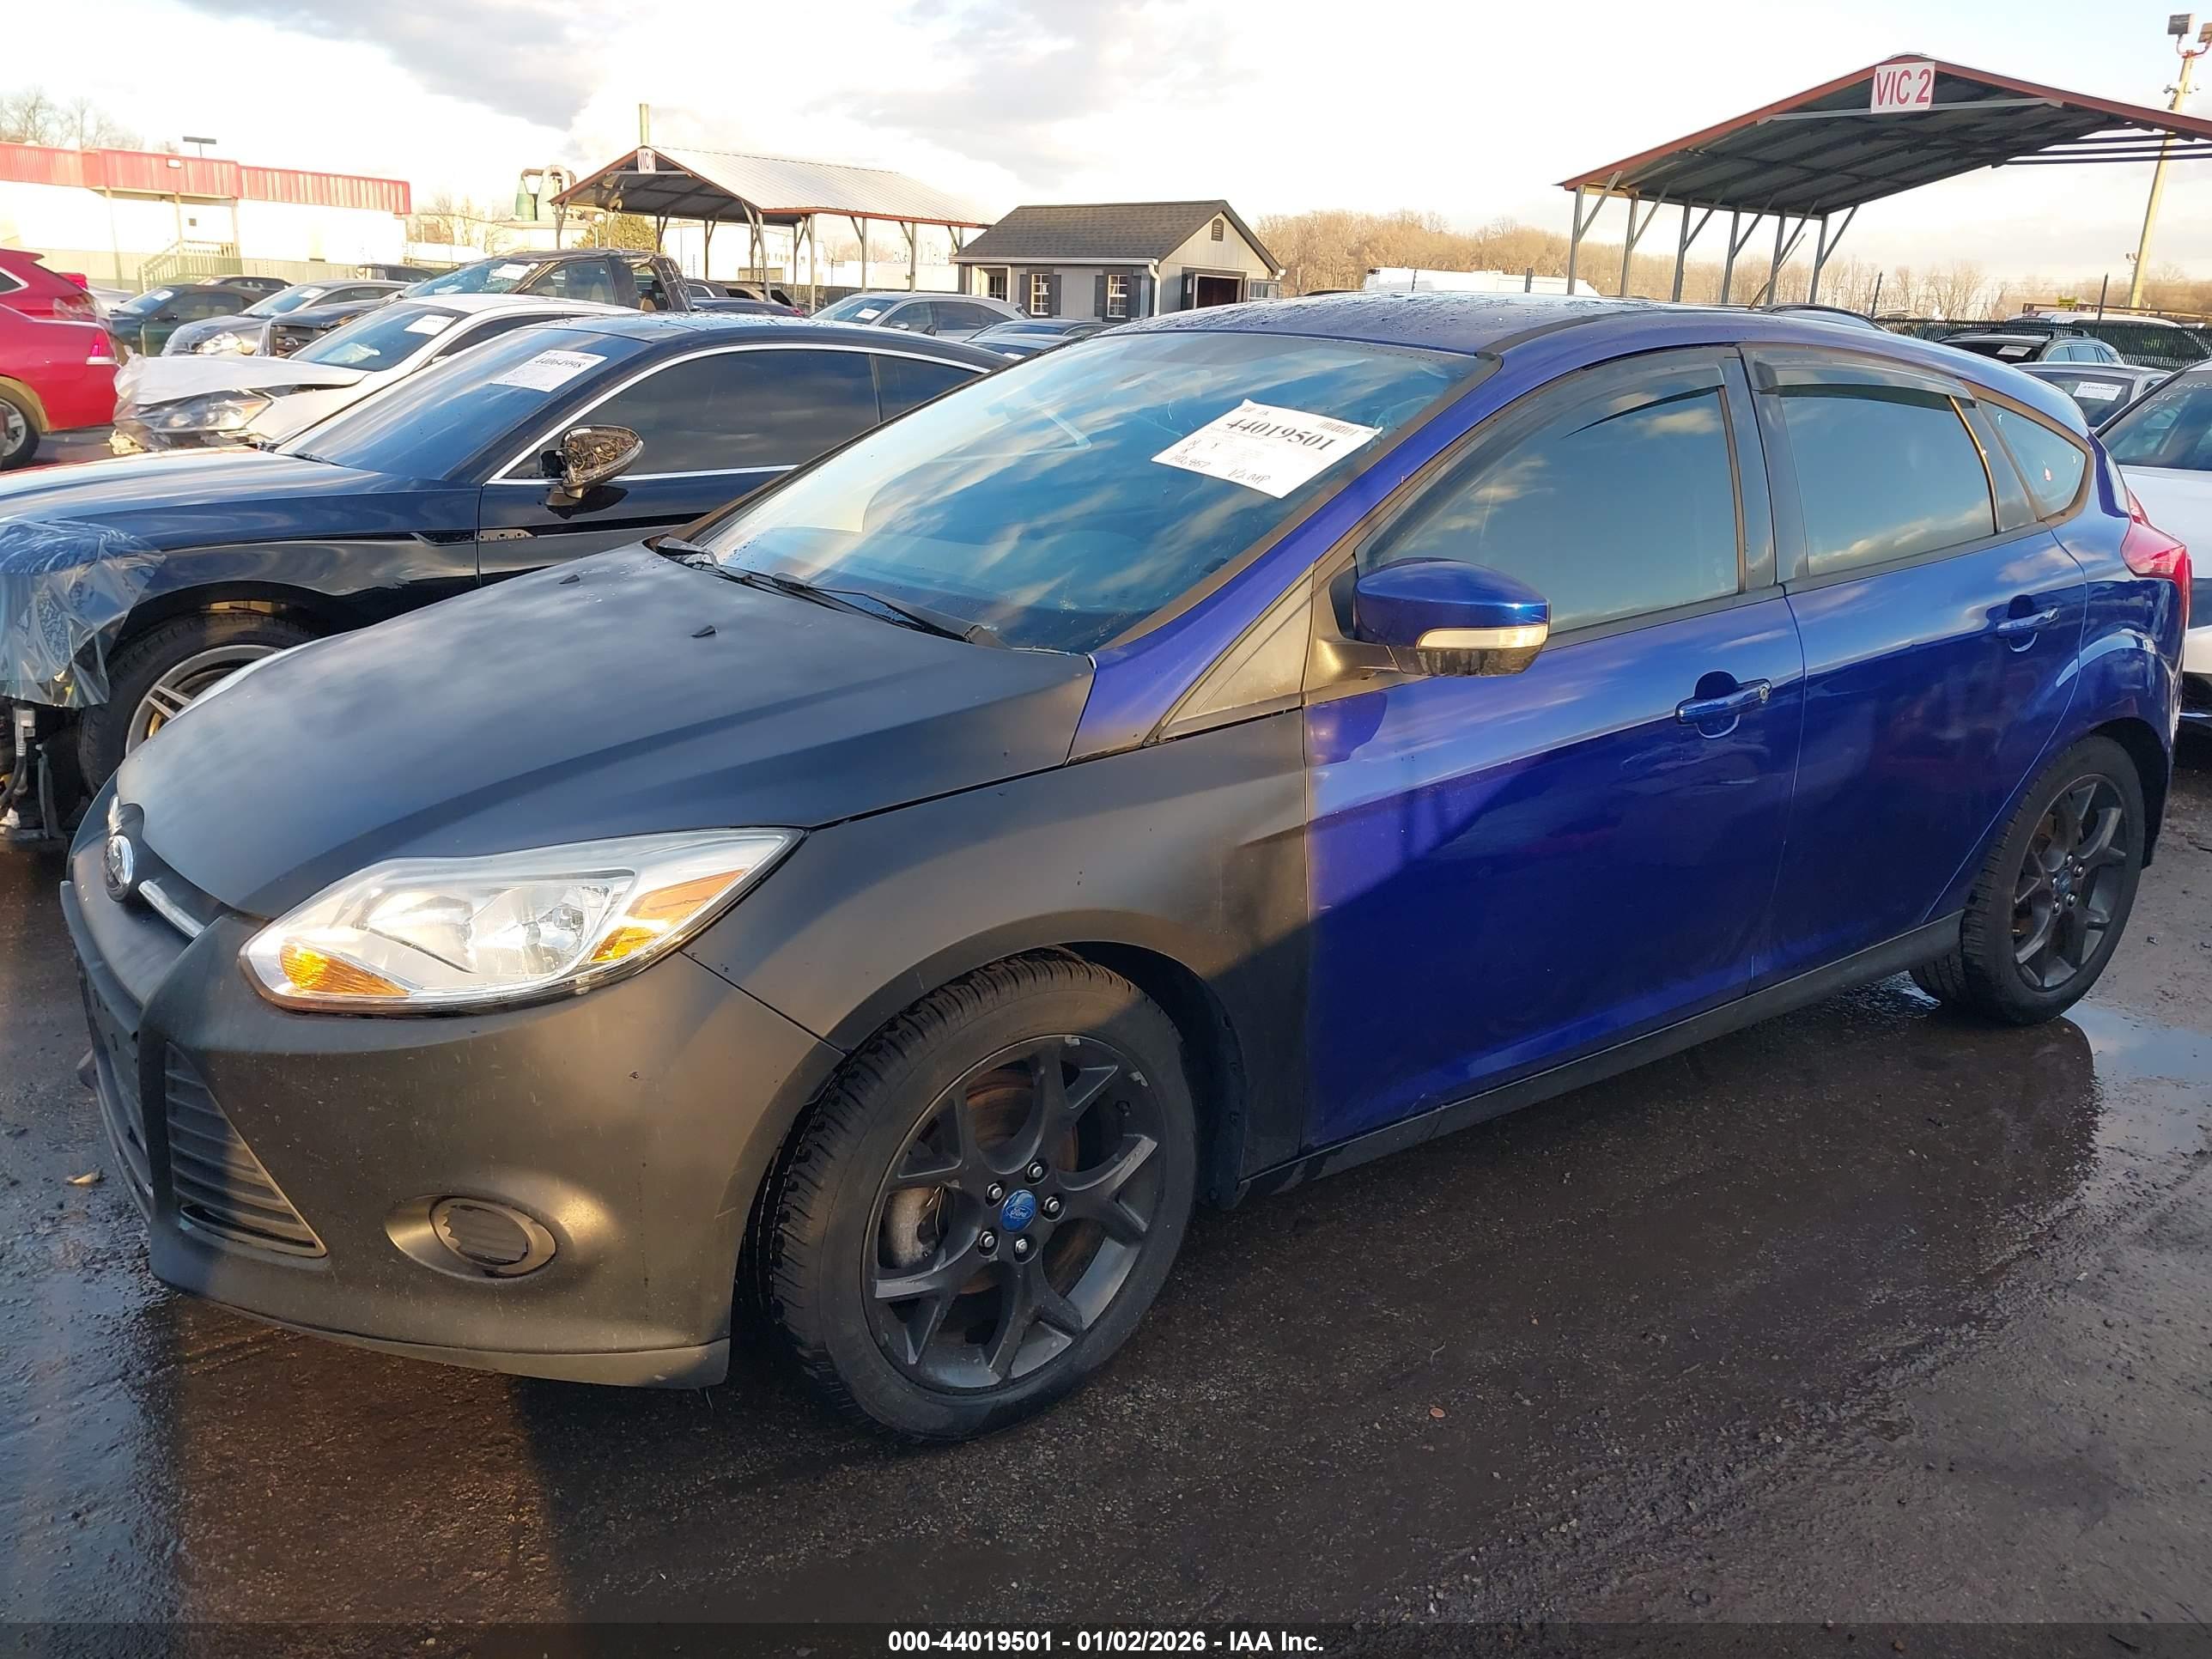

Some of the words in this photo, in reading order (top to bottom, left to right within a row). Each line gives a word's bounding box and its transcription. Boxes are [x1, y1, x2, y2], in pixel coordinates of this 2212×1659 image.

[1877, 70, 1911, 106] VIC
[1916, 69, 1931, 103] 2
[638, 151, 649, 170] VIC
[651, 151, 655, 170] 1
[1226, 418, 1337, 451] 44019501
